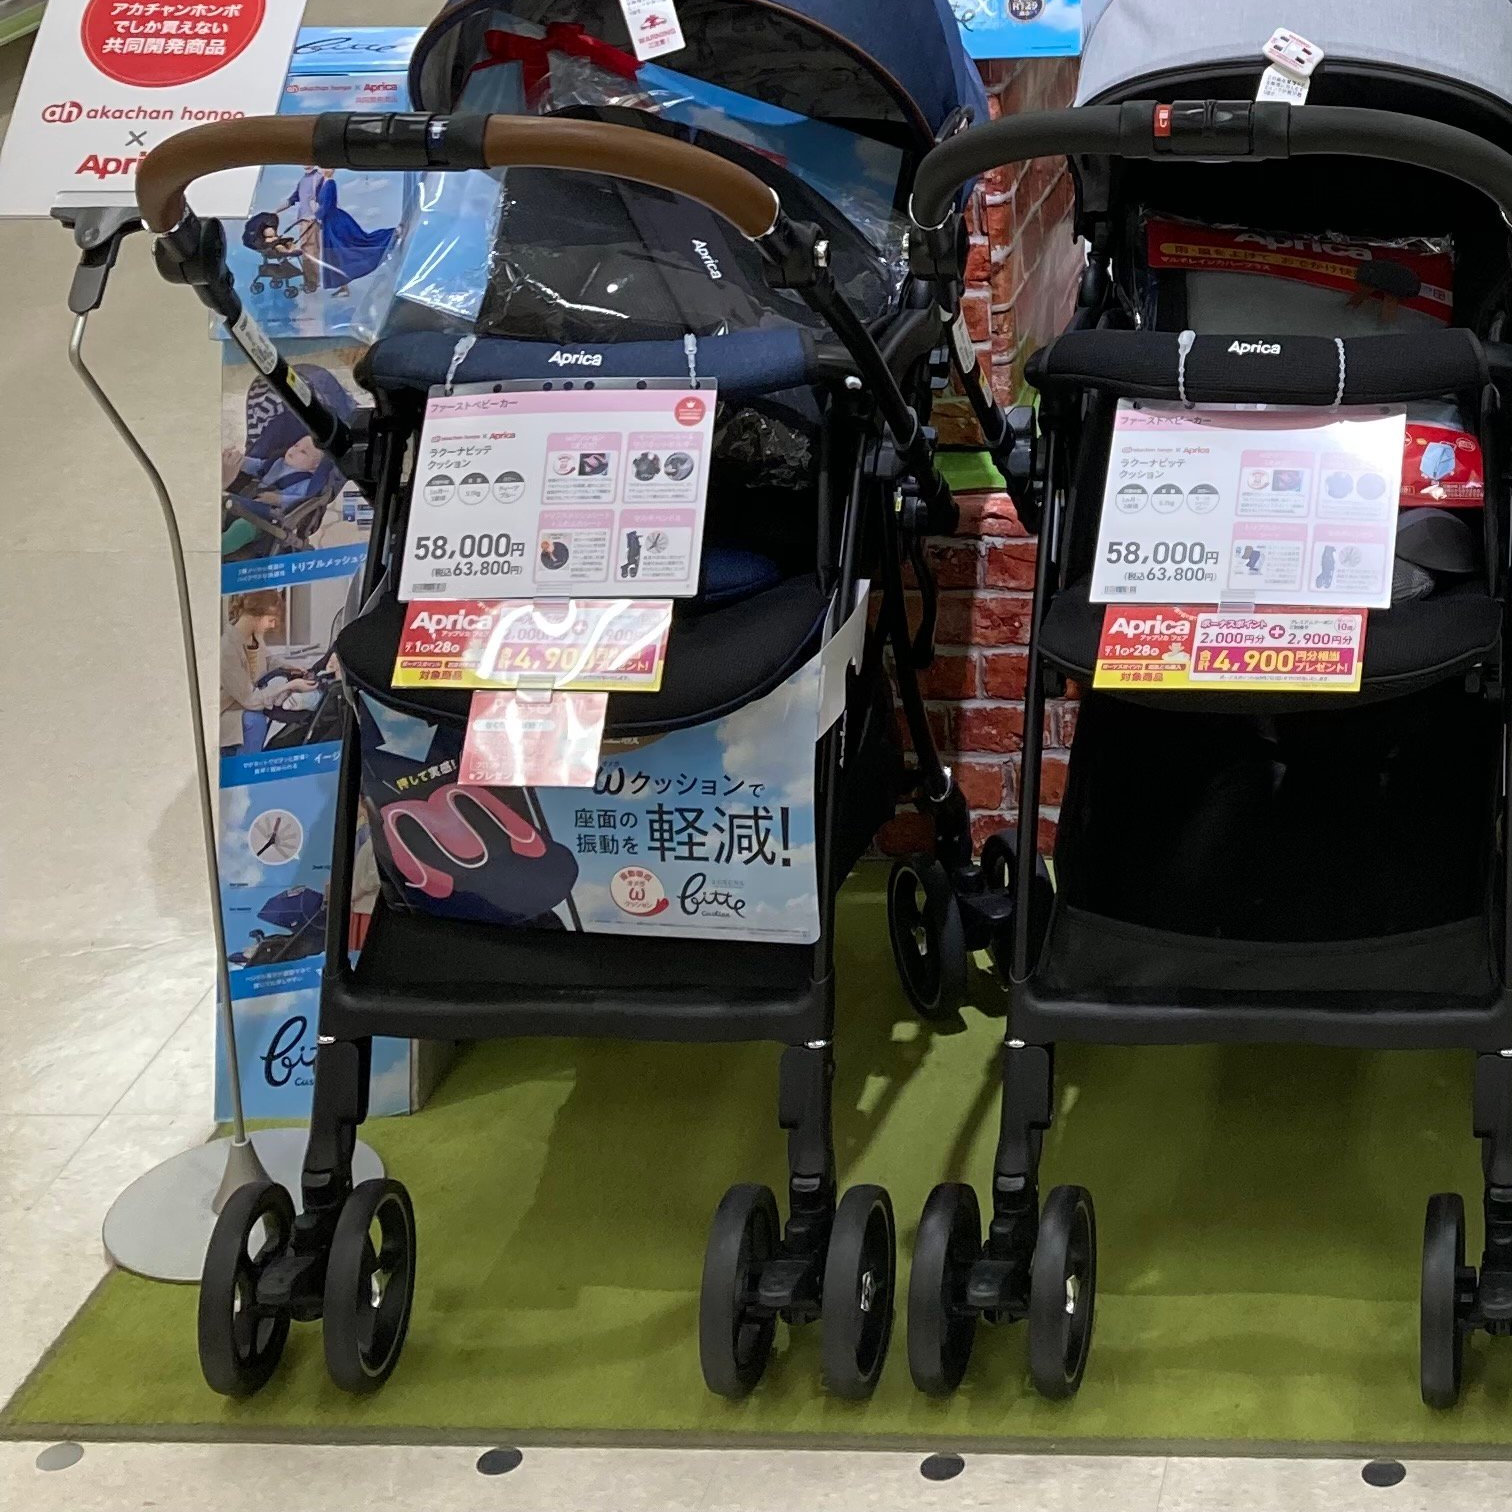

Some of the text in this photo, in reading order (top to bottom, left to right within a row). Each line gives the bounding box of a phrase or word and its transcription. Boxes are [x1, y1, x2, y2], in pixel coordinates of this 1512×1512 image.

[110, 2, 243, 18] アカチャンホンポ
[113, 20, 229, 34] でしか買えない
[102, 37, 227, 56] 共同開発商品
[363, 81, 398, 94] Aprica
[86, 105, 173, 122] akachan
[75, 151, 147, 179] Apri
[691, 238, 722, 280] Aprica
[1227, 340, 1282, 355] Aprica
[548, 350, 603, 367] Aprica
[430, 399, 519, 413] ファーストベビーカー
[427, 459, 471, 471] クッション
[1118, 468, 1165, 481] クッション
[414, 532, 526, 561] 58,000円
[1105, 541, 1219, 566] 58,000円
[410, 609, 493, 639] Aprica
[1107, 614, 1191, 639] Aprica
[1200, 631, 1266, 645] 2,000円分
[1287, 633, 1353, 646] 2,900円分
[574, 808, 638, 830] 座面の
[645, 802, 791, 868] 軽減!
[576, 833, 638, 855] 振動を
